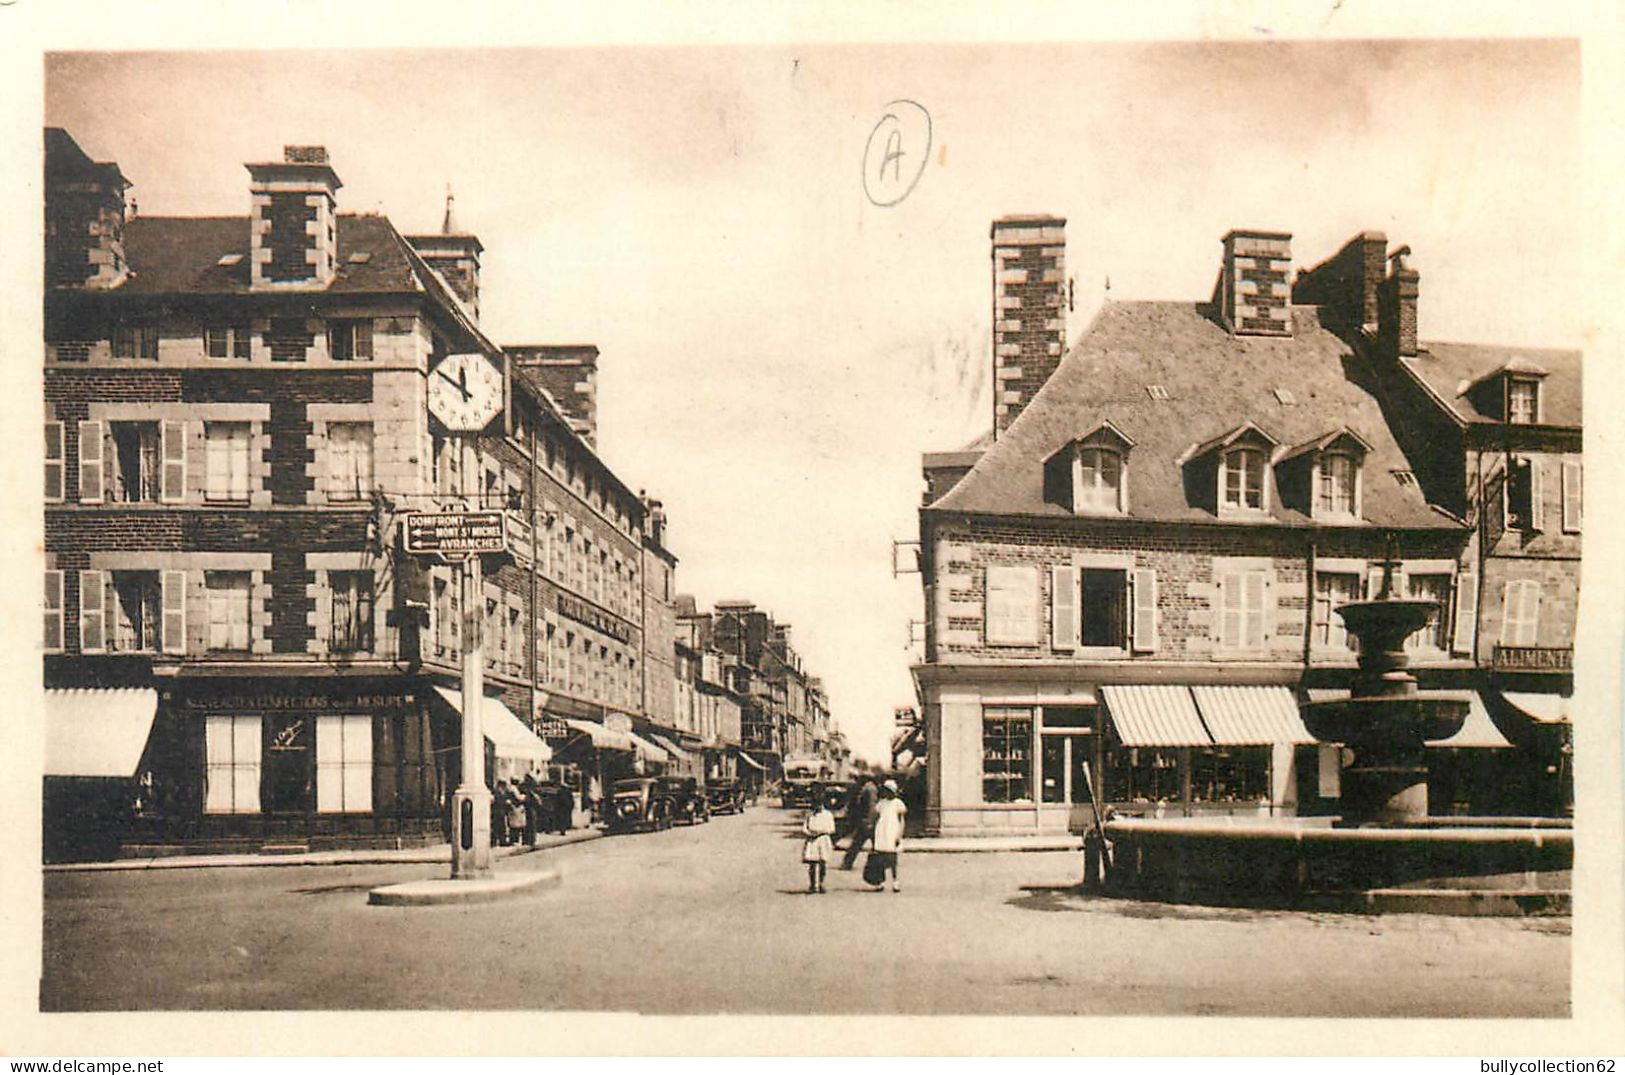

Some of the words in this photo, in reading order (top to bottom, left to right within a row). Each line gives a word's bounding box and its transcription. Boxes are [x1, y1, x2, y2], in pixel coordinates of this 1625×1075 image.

[409, 516, 464, 526] DOMFRONT
[436, 527, 459, 538] MONT
[472, 526, 501, 537] MICHEL
[440, 538, 502, 549] AVRANCHES
